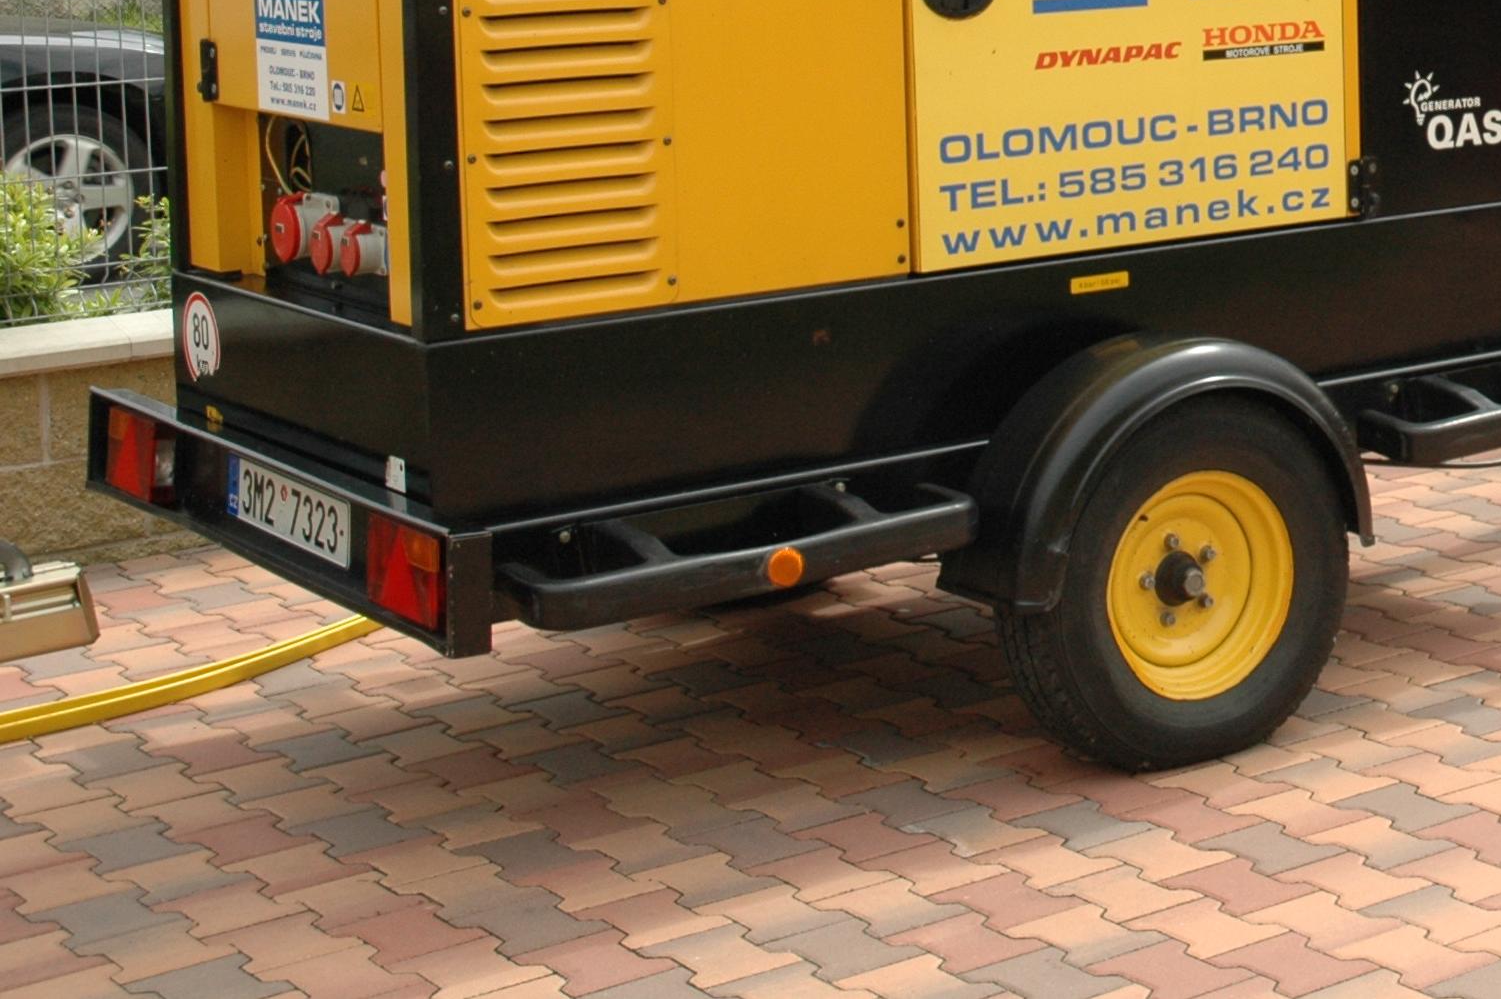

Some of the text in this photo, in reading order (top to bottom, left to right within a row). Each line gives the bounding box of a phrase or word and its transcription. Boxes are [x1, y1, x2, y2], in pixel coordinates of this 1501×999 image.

[1203, 20, 1325, 47] HONDA
[1225, 43, 1304, 58] MOTOROVÉ STROJE
[1034, 42, 1182, 71] DYNAPAC
[1420, 97, 1481, 112] GENERATOR
[939, 114, 1177, 164] OLOMOUC
[1207, 99, 1329, 136] BRNO
[939, 144, 1329, 213] TEL.: 585 316 240
[942, 188, 1330, 255] www.manek.cz
[193, 312, 209, 351] 80
[242, 469, 339, 554] 3M2 7323
